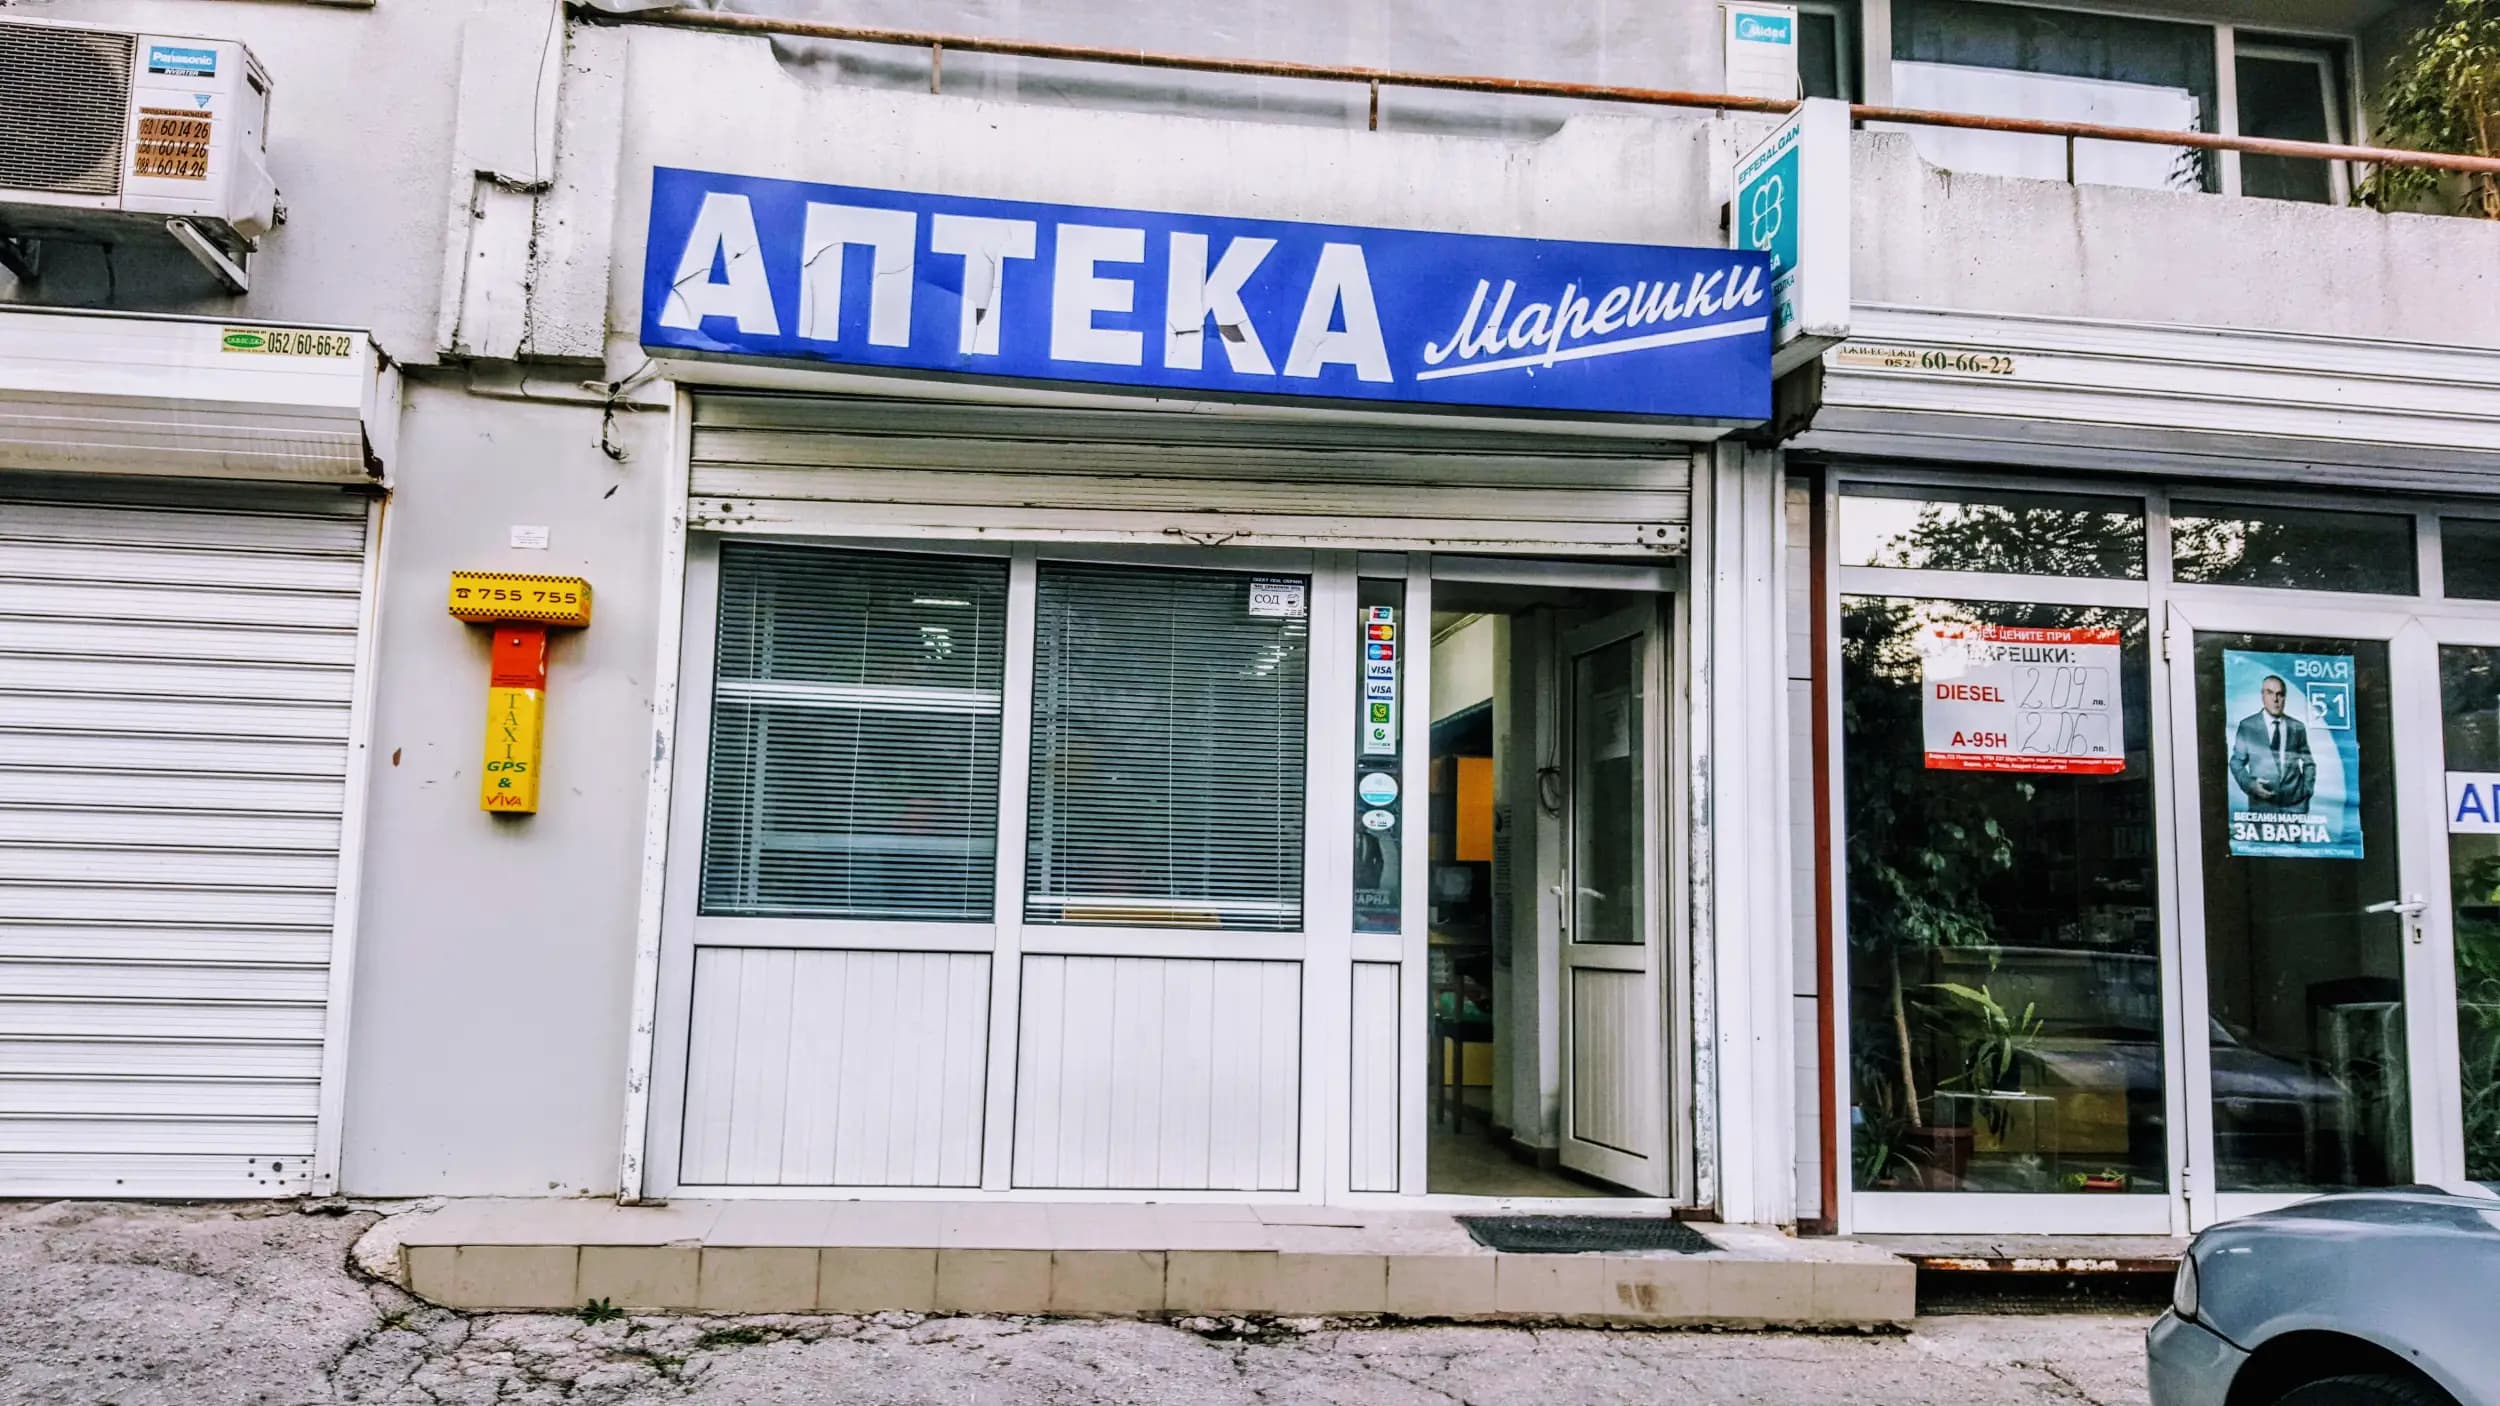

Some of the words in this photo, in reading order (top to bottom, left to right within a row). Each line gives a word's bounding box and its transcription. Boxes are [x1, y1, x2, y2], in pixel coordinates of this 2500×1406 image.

[152, 52, 214, 65] Panasonic
[163, 69, 199, 77] INVERTER
[178, 122, 192, 137] 14
[193, 123, 209, 139] 26
[1738, 124, 1800, 184] EFFERALGAN
[659, 191, 1394, 384] АПТЕКА
[1423, 263, 1765, 369] Марешки
[267, 332, 351, 357] 052/60-66-22
[1921, 350, 2013, 375] 60-66-22
[478, 589, 522, 601] 755
[533, 591, 577, 604] 755
[1254, 593, 1280, 605] СОД
[1999, 629, 2044, 641] ЦЕНИТЕ
[2046, 631, 2071, 641] ПРИ
[1371, 666, 1392, 674] VISA
[2294, 660, 2348, 679] ВОЛЯ
[1371, 685, 1392, 694] VISA
[1936, 684, 2005, 702] DIESEL
[2310, 693, 2345, 718] 51
[503, 693, 522, 759] TAXI
[2020, 712, 2088, 756] 2.06
[487, 761, 527, 773] GPS
[498, 777, 512, 788] &
[2456, 783, 2500, 823] А
[2233, 812, 2277, 823] ВЕСЕЛИН
[2233, 823, 2259, 841] ЗА
[2262, 824, 2331, 843] ВАРНА
